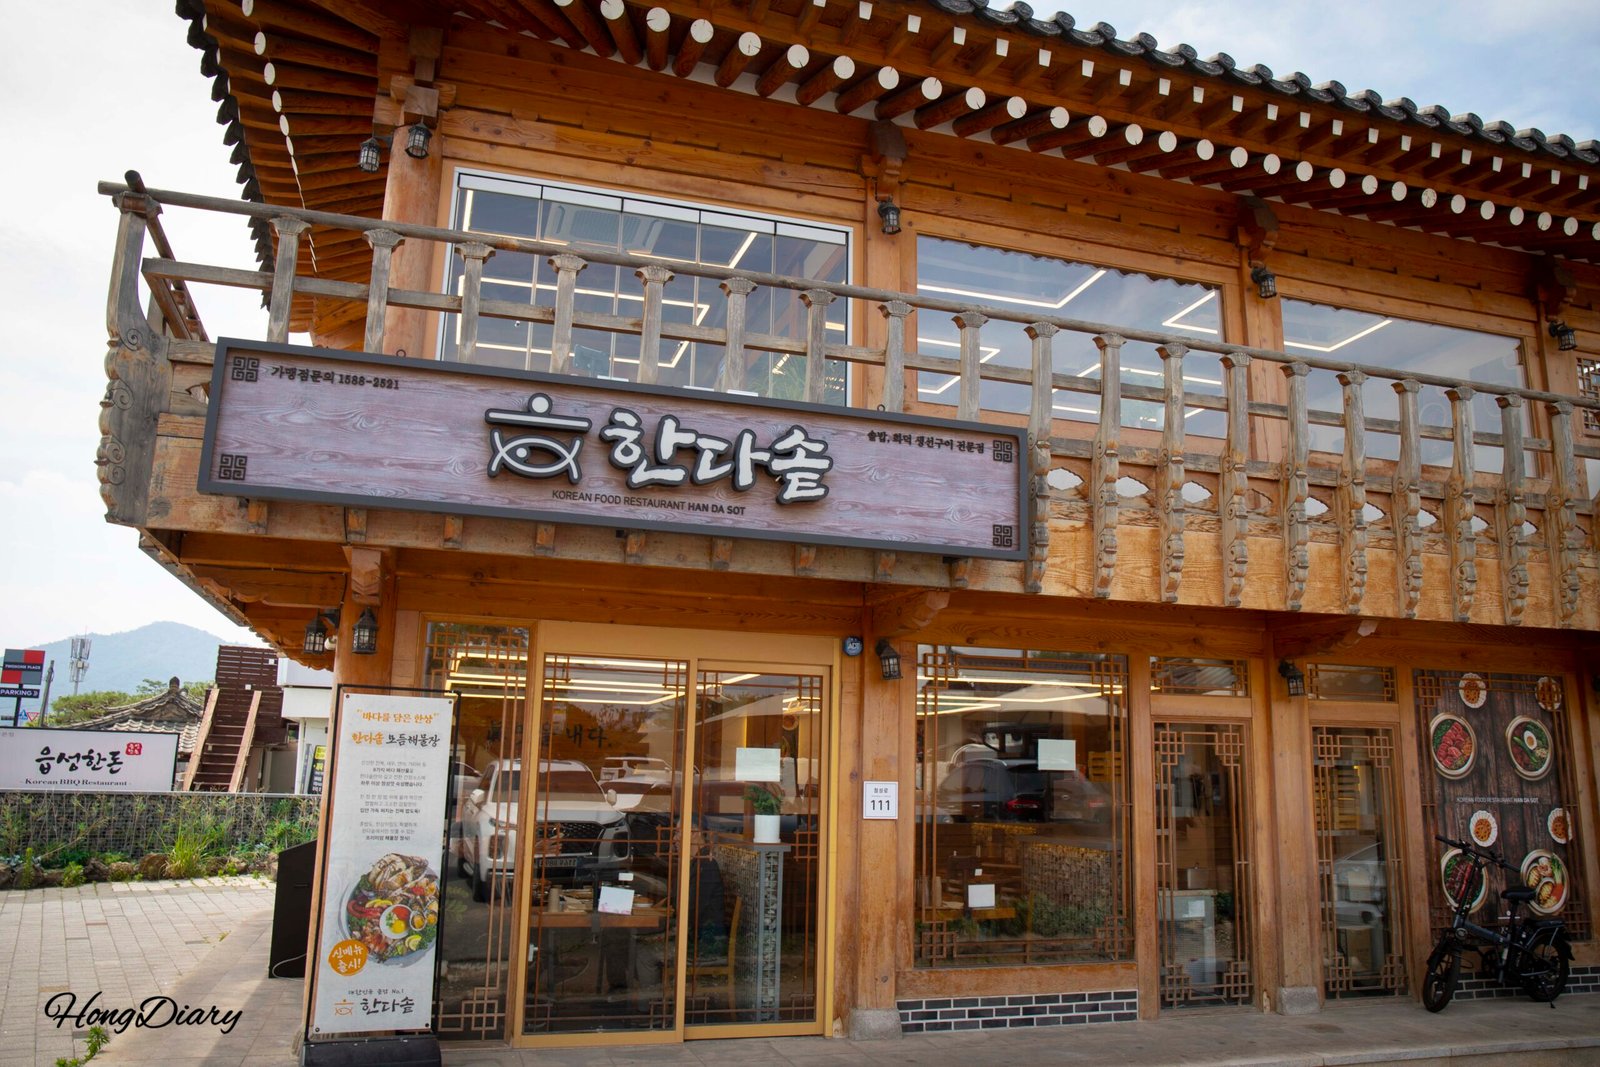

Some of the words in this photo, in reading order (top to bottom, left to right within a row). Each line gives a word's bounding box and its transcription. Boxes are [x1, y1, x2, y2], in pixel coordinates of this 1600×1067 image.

[271, 366, 335, 384] 가맹점문의
[339, 374, 400, 390] 1588-2521
[893, 433, 912, 445] 화덕
[915, 436, 953, 450] 생선구이
[956, 441, 984, 454] 전문점
[600, 408, 832, 503] 한다솥
[552, 489, 593, 501] KOREAN
[595, 493, 622, 505] FOOD
[624, 495, 686, 511] RESTAURANT
[688, 502, 709, 513] HAN
[711, 503, 725, 514] DA
[727, 505, 746, 516] SOT
[394, 713, 412, 724] 담은
[386, 733, 440, 747] 모듬해물장
[35, 746, 123, 775] 읍성한돈
[870, 799, 890, 811] 111
[332, 944, 363, 959] 신메뉴
[337, 958, 361, 972] 출시!
[360, 996, 415, 1015] 한다솥
